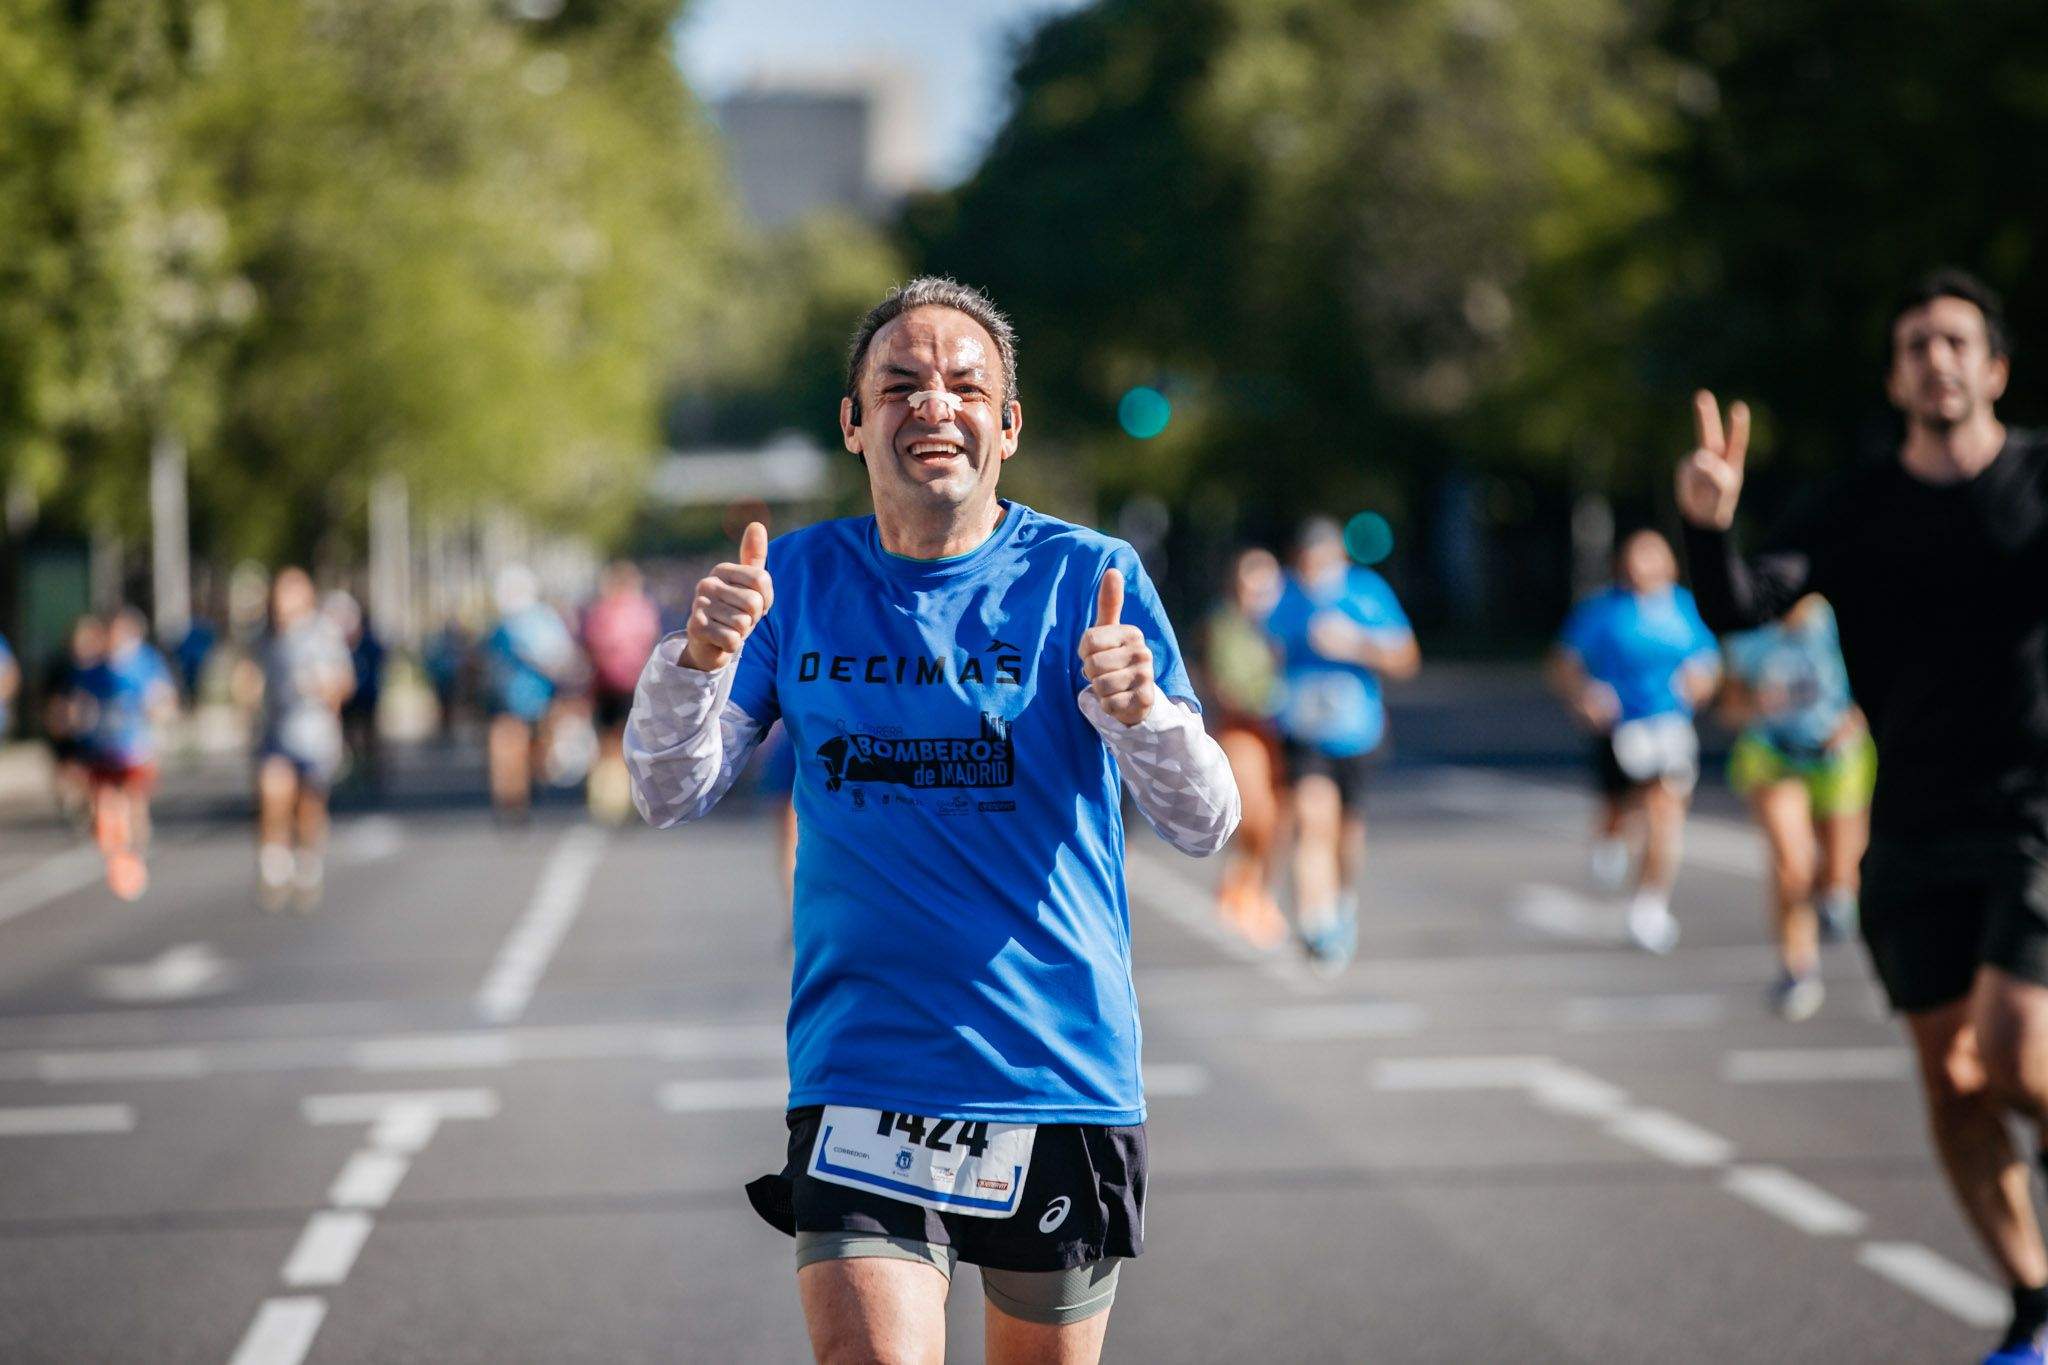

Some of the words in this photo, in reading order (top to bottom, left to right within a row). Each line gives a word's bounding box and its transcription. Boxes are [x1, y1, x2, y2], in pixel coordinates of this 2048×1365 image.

[798, 652, 1022, 685] DECIMAS
[856, 736, 1007, 762] BOMBEROS
[914, 764, 936, 786] de
[941, 760, 1008, 786] MADRID
[877, 1109, 989, 1158] 1424
